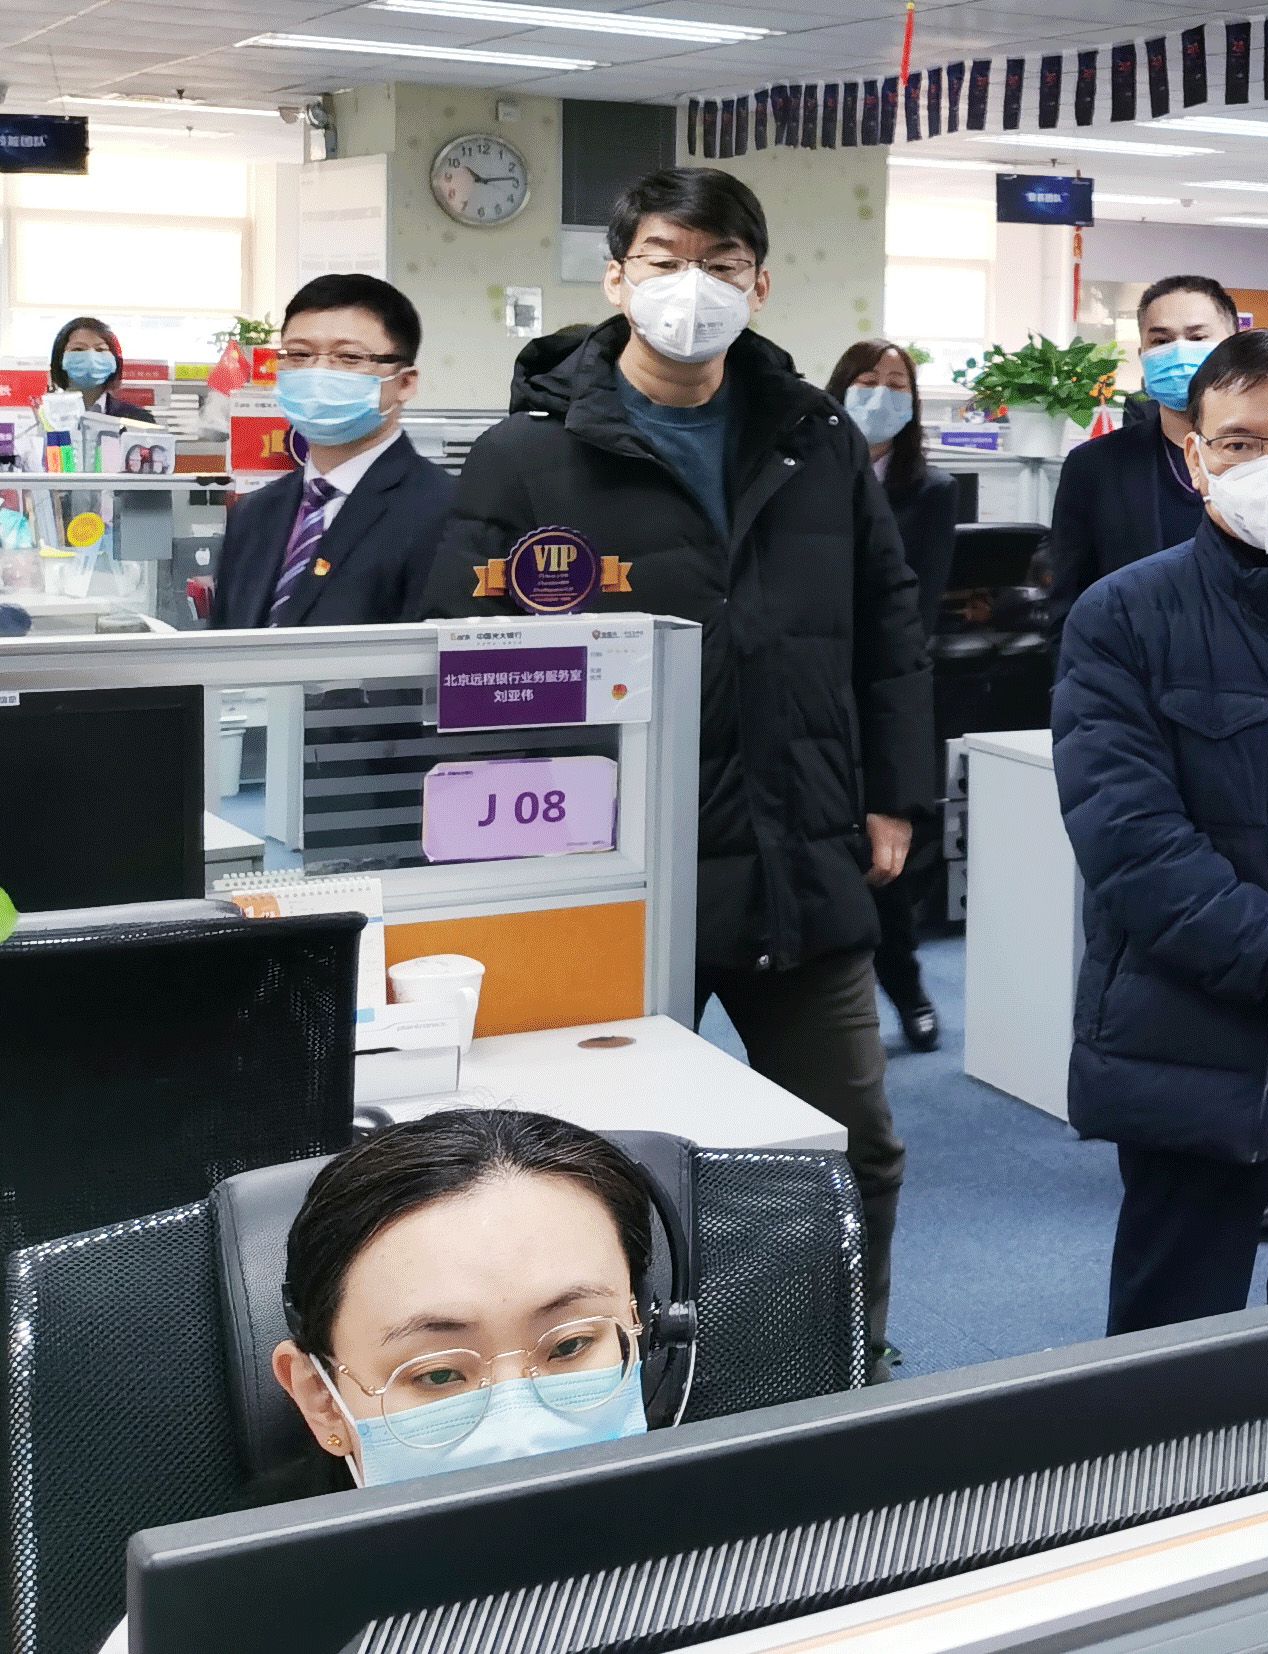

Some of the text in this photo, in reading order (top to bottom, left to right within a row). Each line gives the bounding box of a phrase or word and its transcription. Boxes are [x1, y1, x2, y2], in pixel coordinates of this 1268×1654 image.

[533, 544, 577, 572] VIP
[444, 669, 582, 687] 北京远程银行业务服务室
[493, 689, 534, 703] 刘亚伟
[478, 790, 566, 827] J 08
